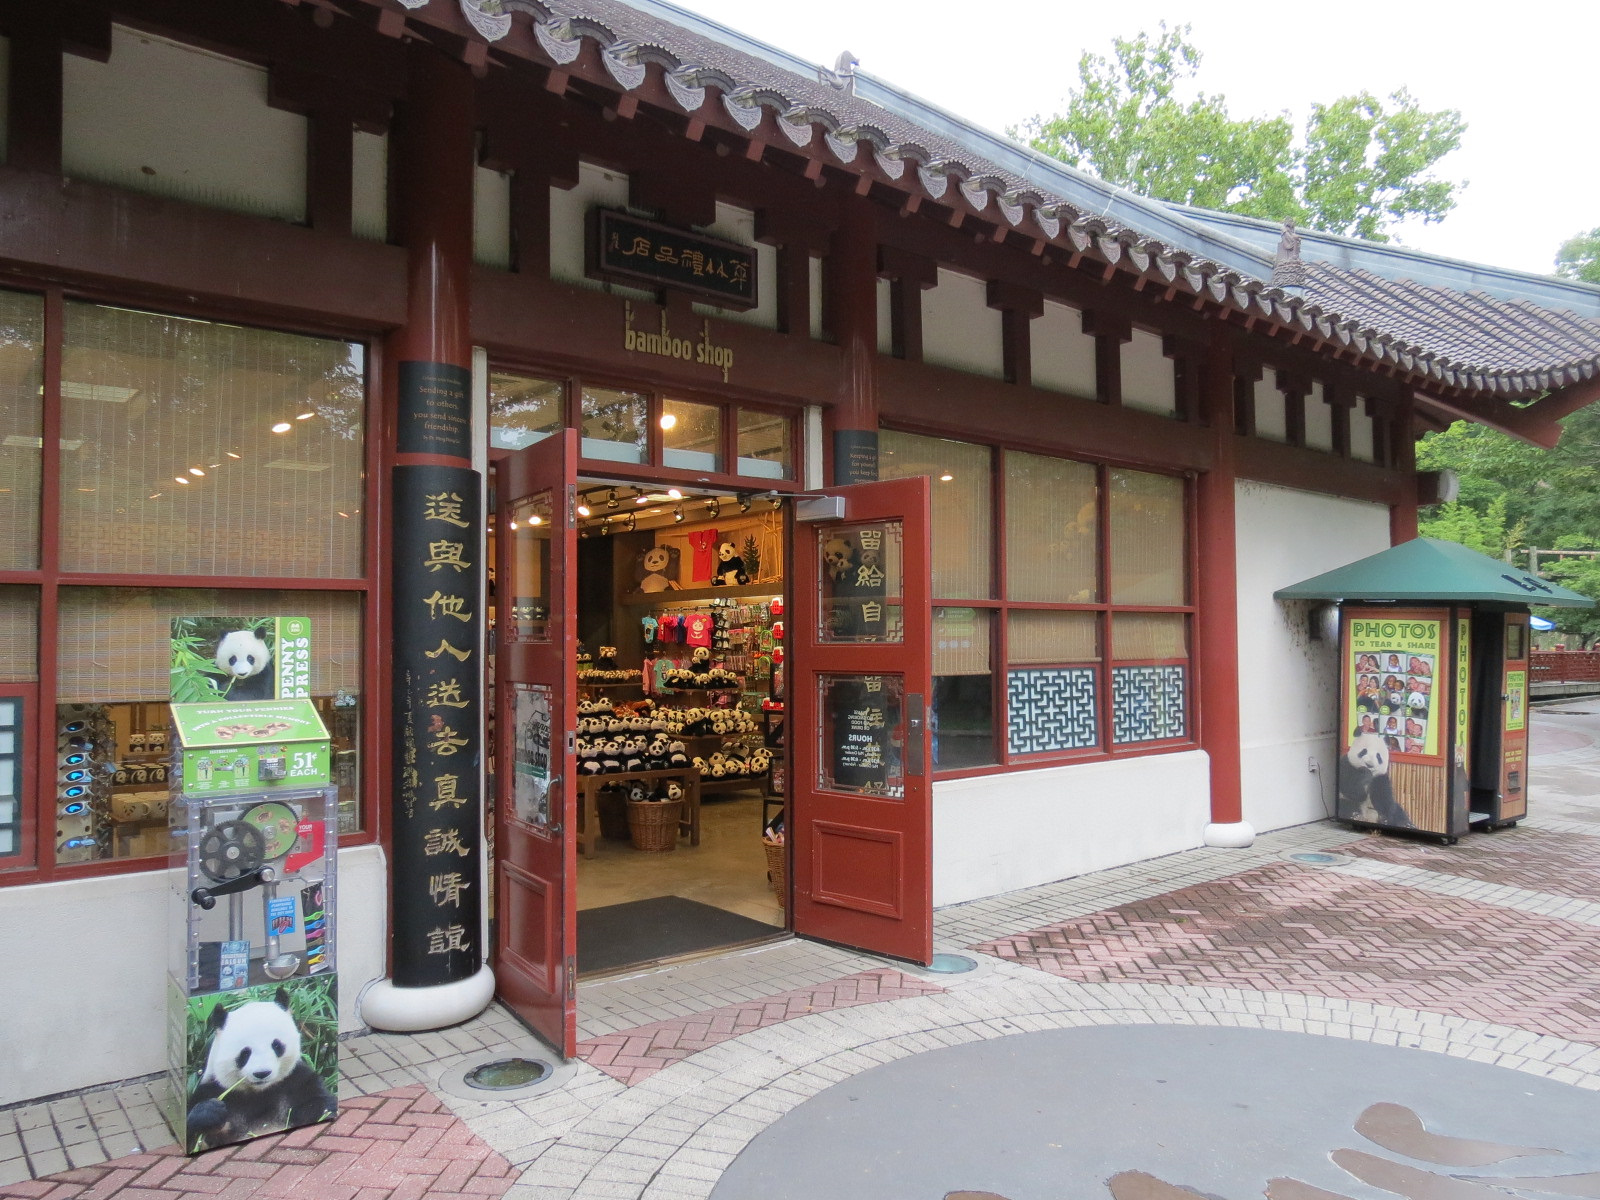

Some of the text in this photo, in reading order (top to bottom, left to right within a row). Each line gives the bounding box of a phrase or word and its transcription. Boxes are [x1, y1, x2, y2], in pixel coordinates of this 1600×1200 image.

[624, 300, 734, 384] bamboo shop
[419, 385, 448, 397] Sending
[413, 412, 429, 420] you
[430, 412, 447, 421] send
[1353, 622, 1436, 640] PHOTOS
[1407, 642, 1436, 650] SHARE
[281, 637, 295, 699] PENNY
[295, 637, 309, 699] PRESS
[1458, 623, 1468, 747] PHOTOS
[290, 768, 318, 777] EACH
